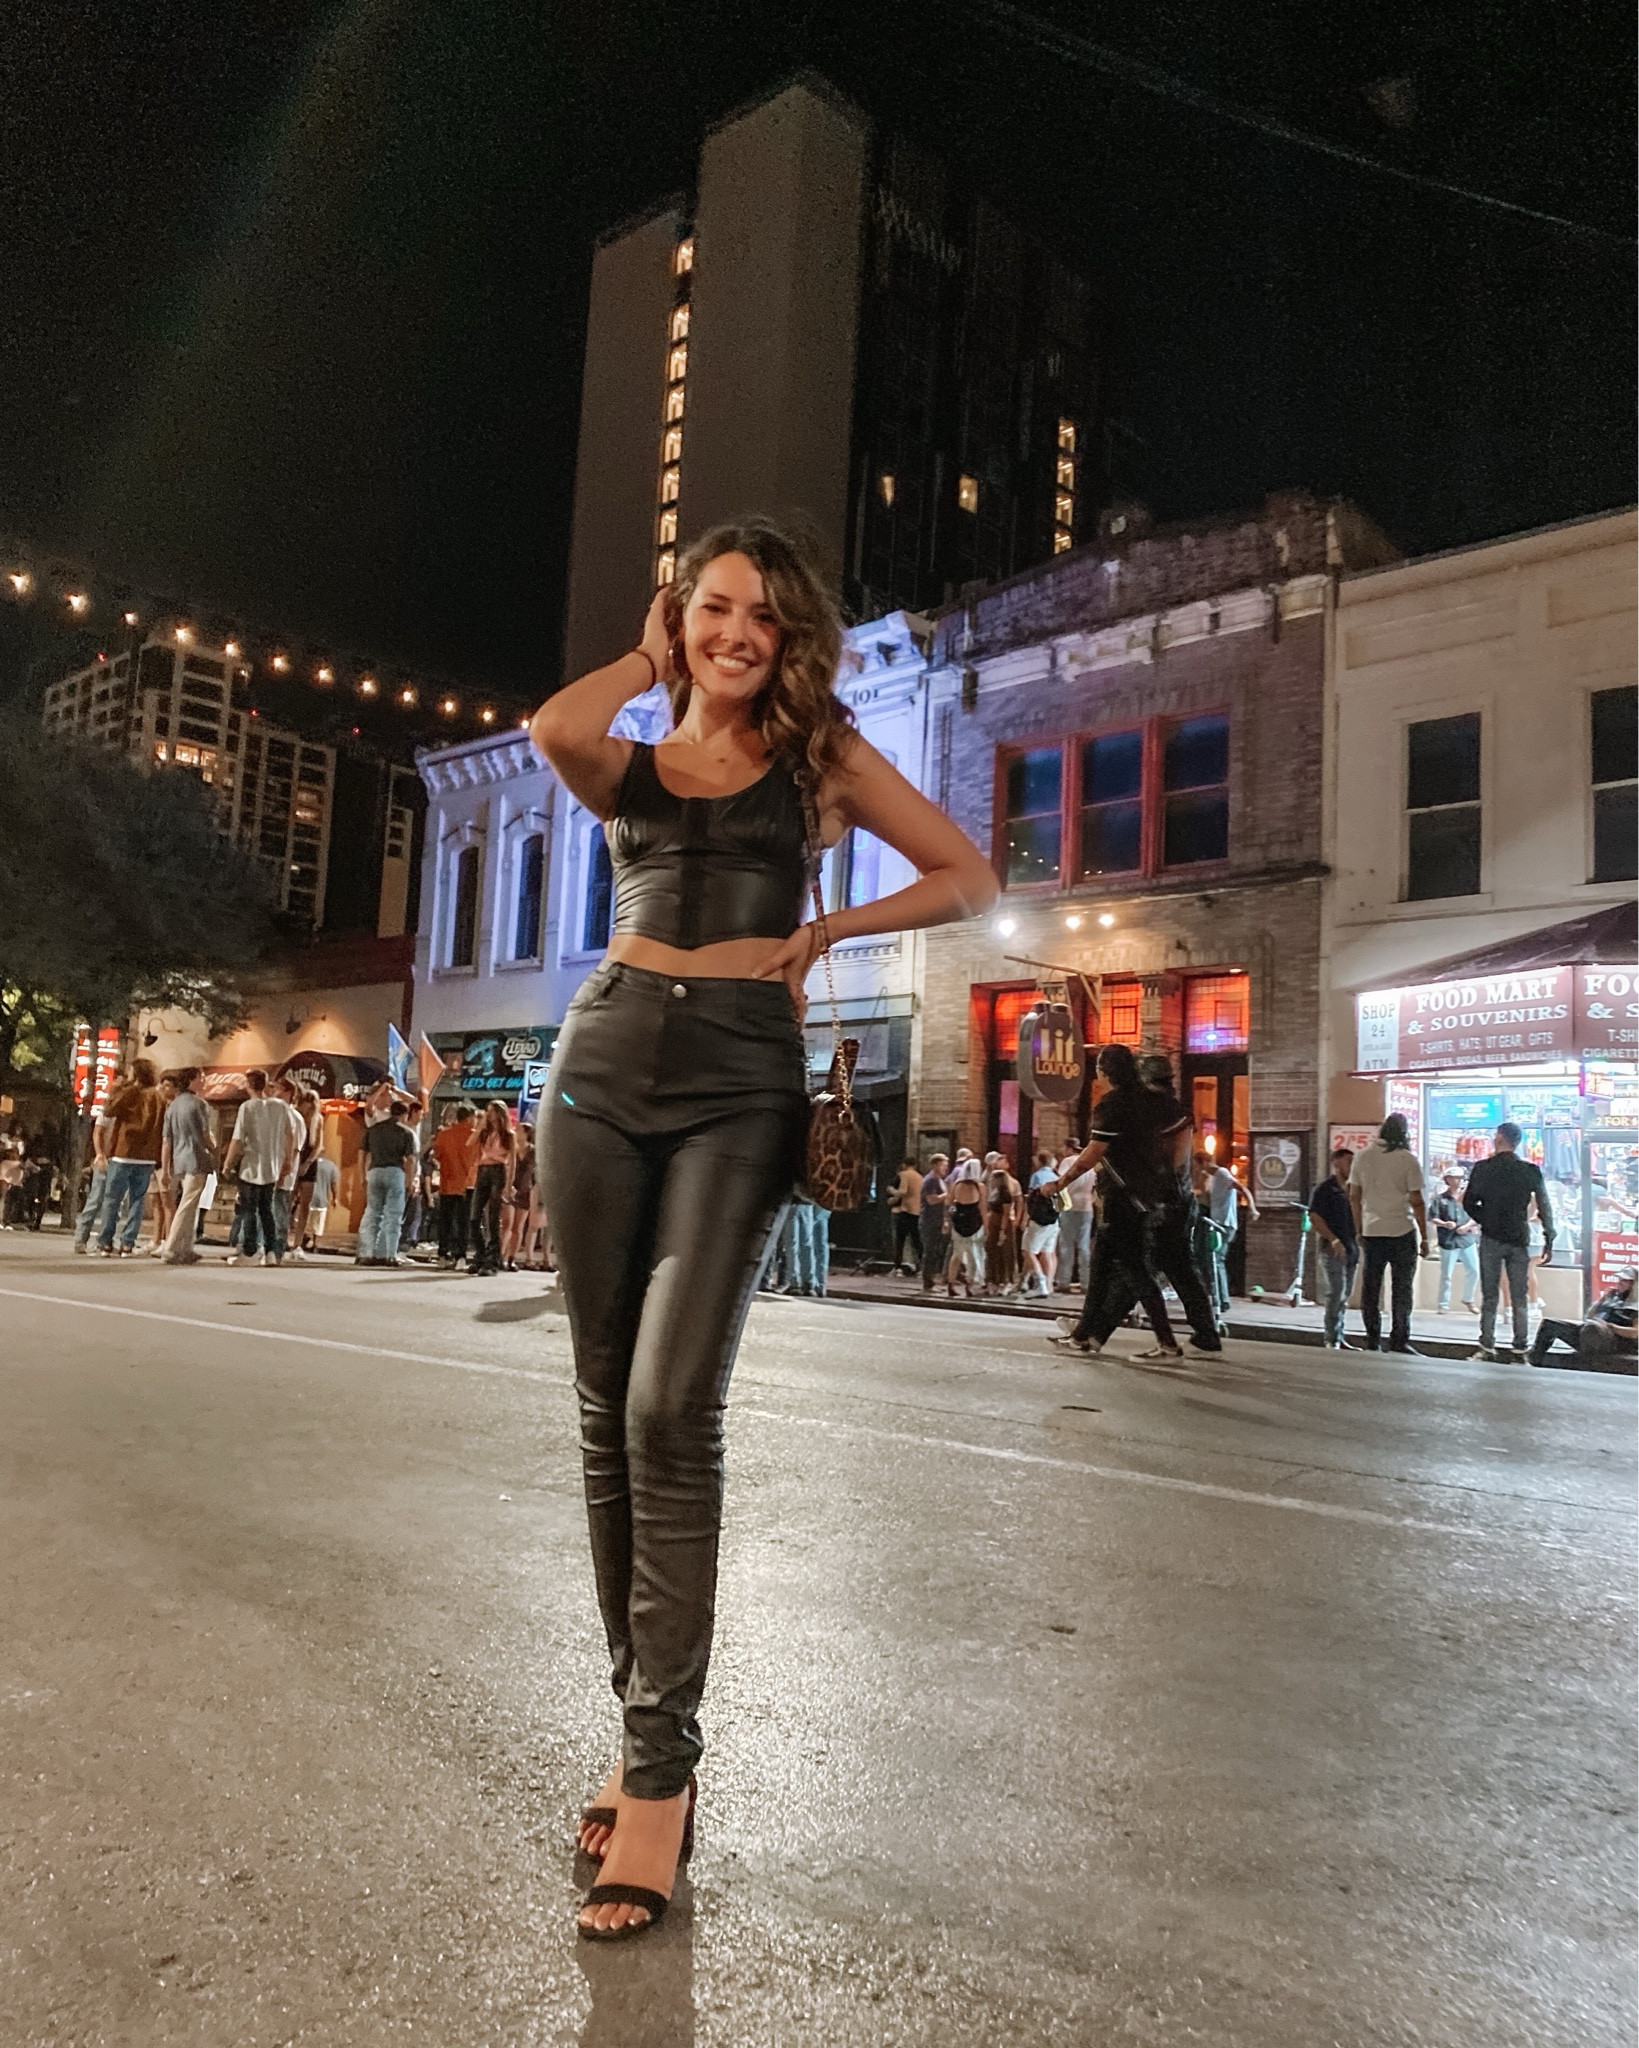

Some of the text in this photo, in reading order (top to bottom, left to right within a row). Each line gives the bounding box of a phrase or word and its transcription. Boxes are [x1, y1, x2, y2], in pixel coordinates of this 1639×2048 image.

[1416, 976, 1557, 1013] FOOD MART
[1584, 974, 1638, 996] FO
[1362, 1003, 1395, 1020] SHOP
[1407, 1004, 1567, 1035] & SOUVENIRS
[1587, 1002, 1614, 1019] &
[1371, 1024, 1386, 1037] 24
[1528, 1031, 1554, 1046] GIFTS
[1040, 1028, 1075, 1063] Lit
[1035, 1056, 1080, 1080] Lounge
[1364, 1059, 1389, 1070] ATM
